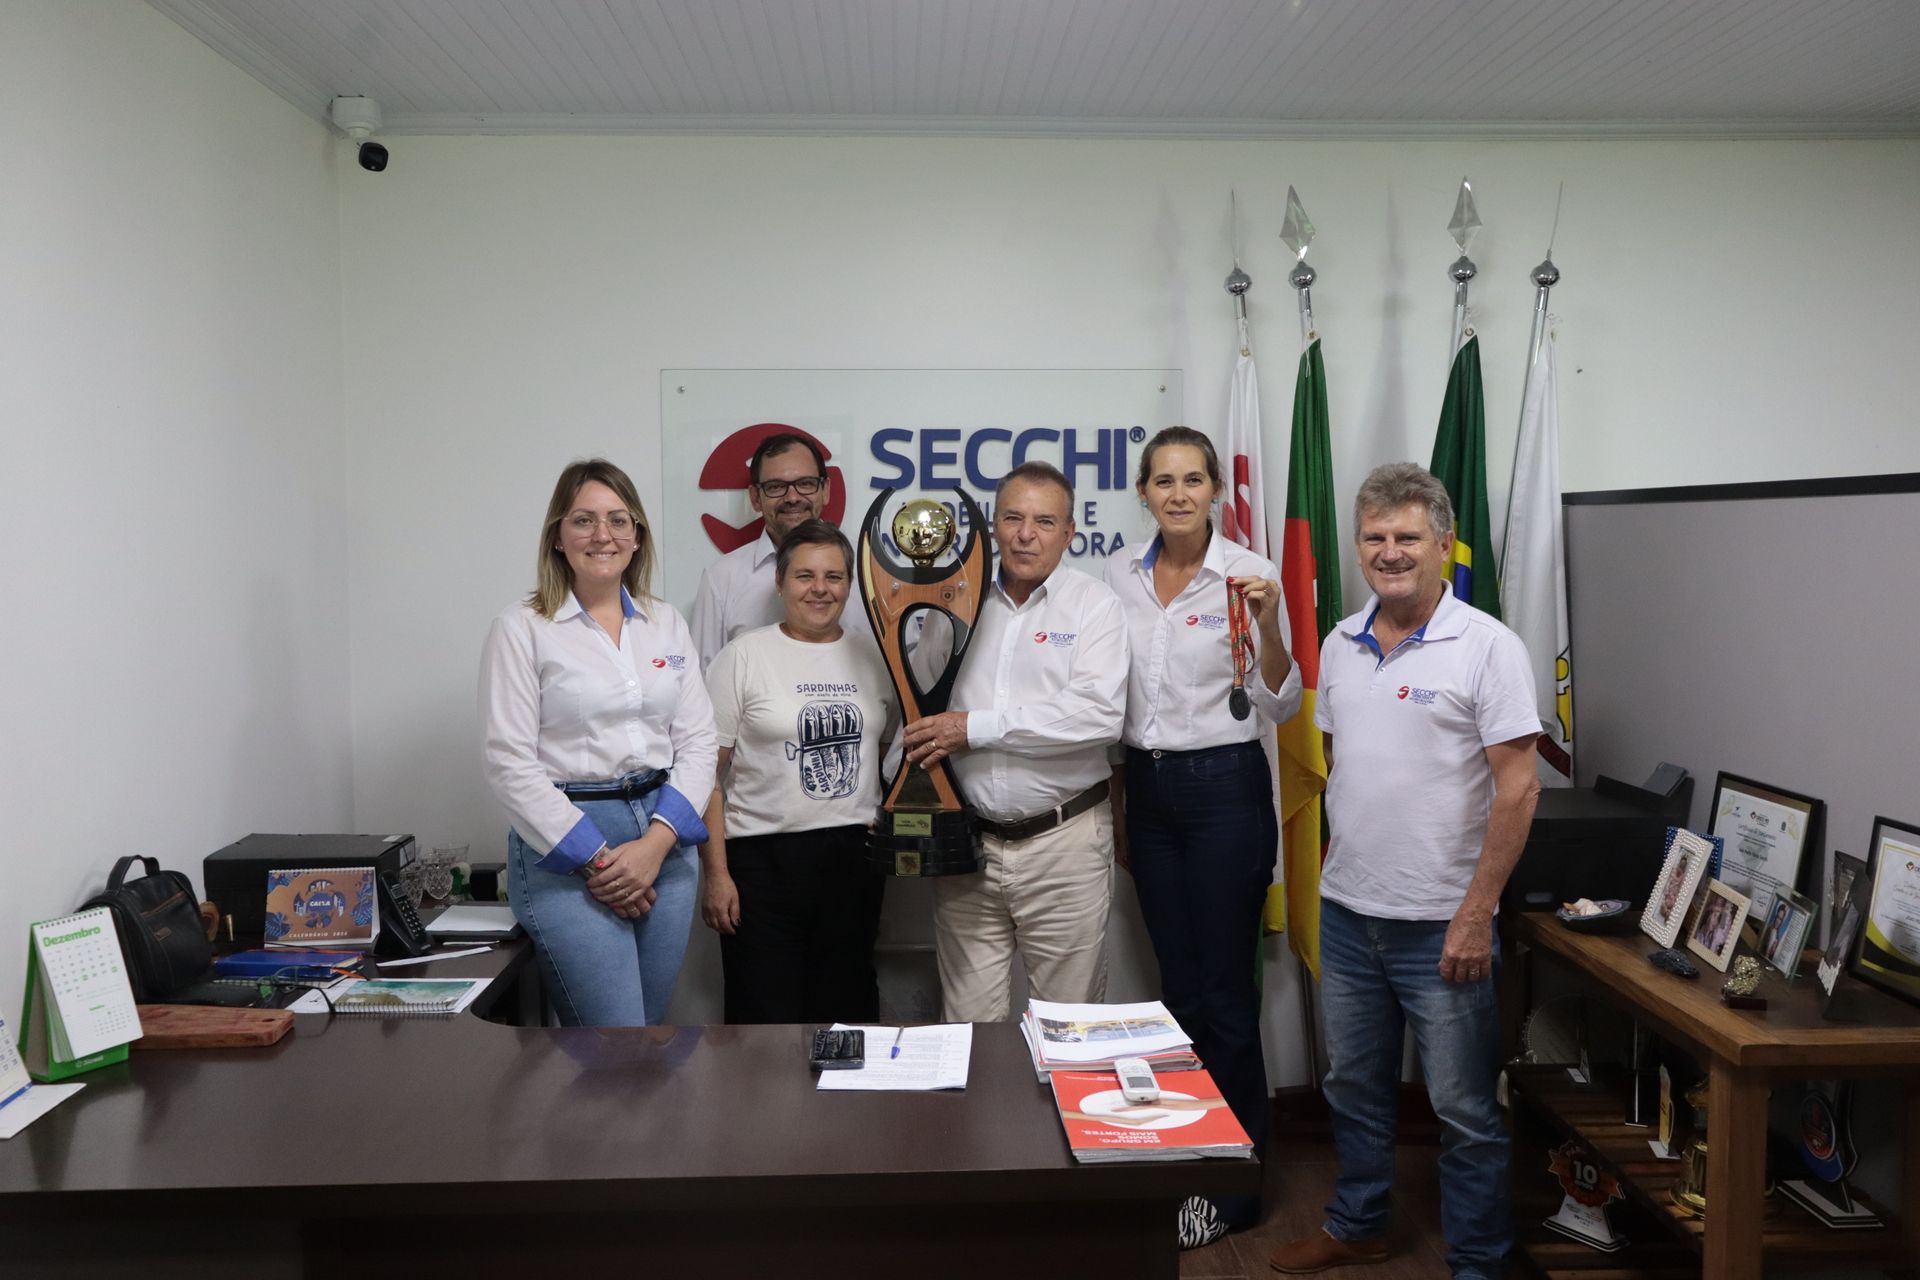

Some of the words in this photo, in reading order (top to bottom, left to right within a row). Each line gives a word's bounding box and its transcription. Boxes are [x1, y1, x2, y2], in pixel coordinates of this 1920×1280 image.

[1084, 501, 1097, 525] E
[796, 683, 858, 693] SARDINHAS
[810, 750, 831, 793] SARDINHA
[42, 926, 101, 947] Dezembro
[1573, 1160, 1598, 1185] 10
